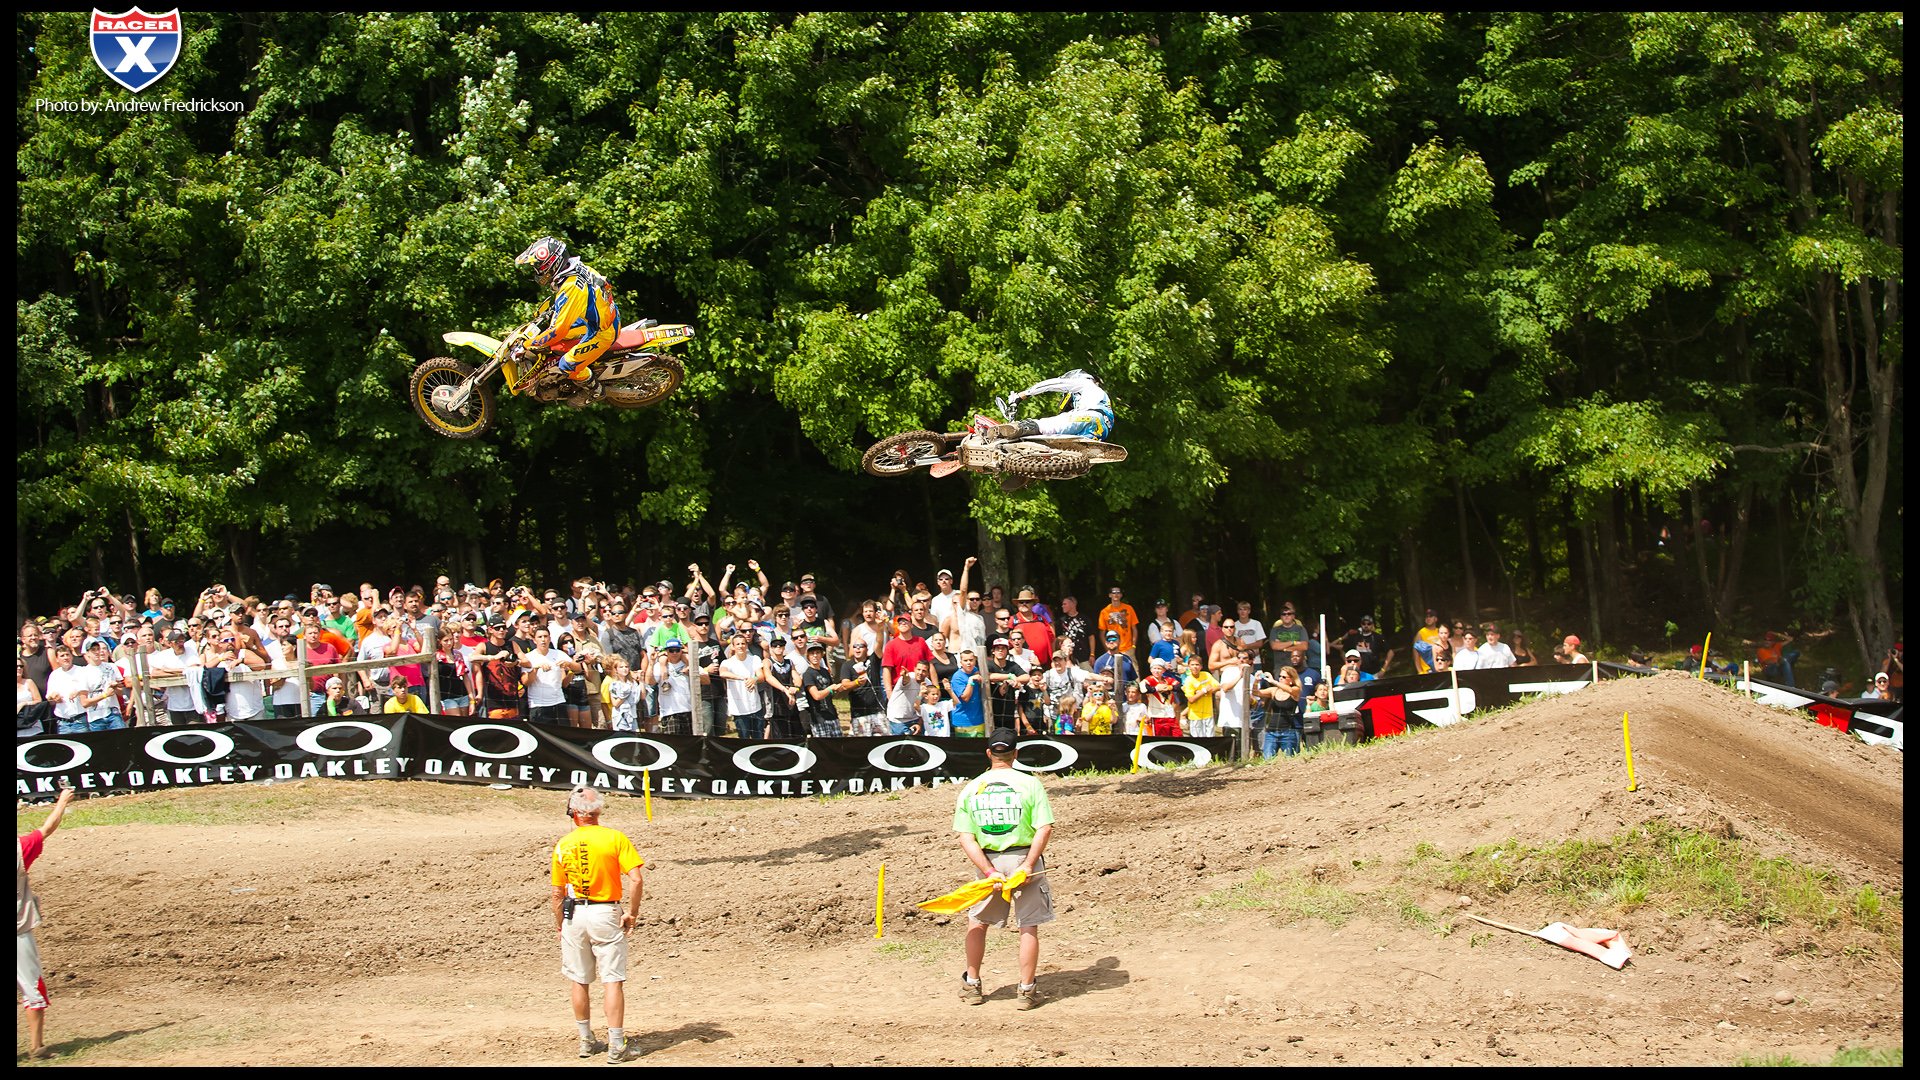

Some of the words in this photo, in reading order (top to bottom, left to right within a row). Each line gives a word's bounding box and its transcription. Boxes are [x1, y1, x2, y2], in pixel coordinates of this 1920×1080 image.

[573, 342, 600, 356] FOX
[127, 765, 259, 786] OAKLEY
[274, 757, 411, 780] OAKLEY
[424, 758, 558, 783] OAKLEY
[570, 771, 698, 794] OAKLEY
[711, 779, 835, 795] OAKLEY
[580, 841, 589, 874] STAFF
